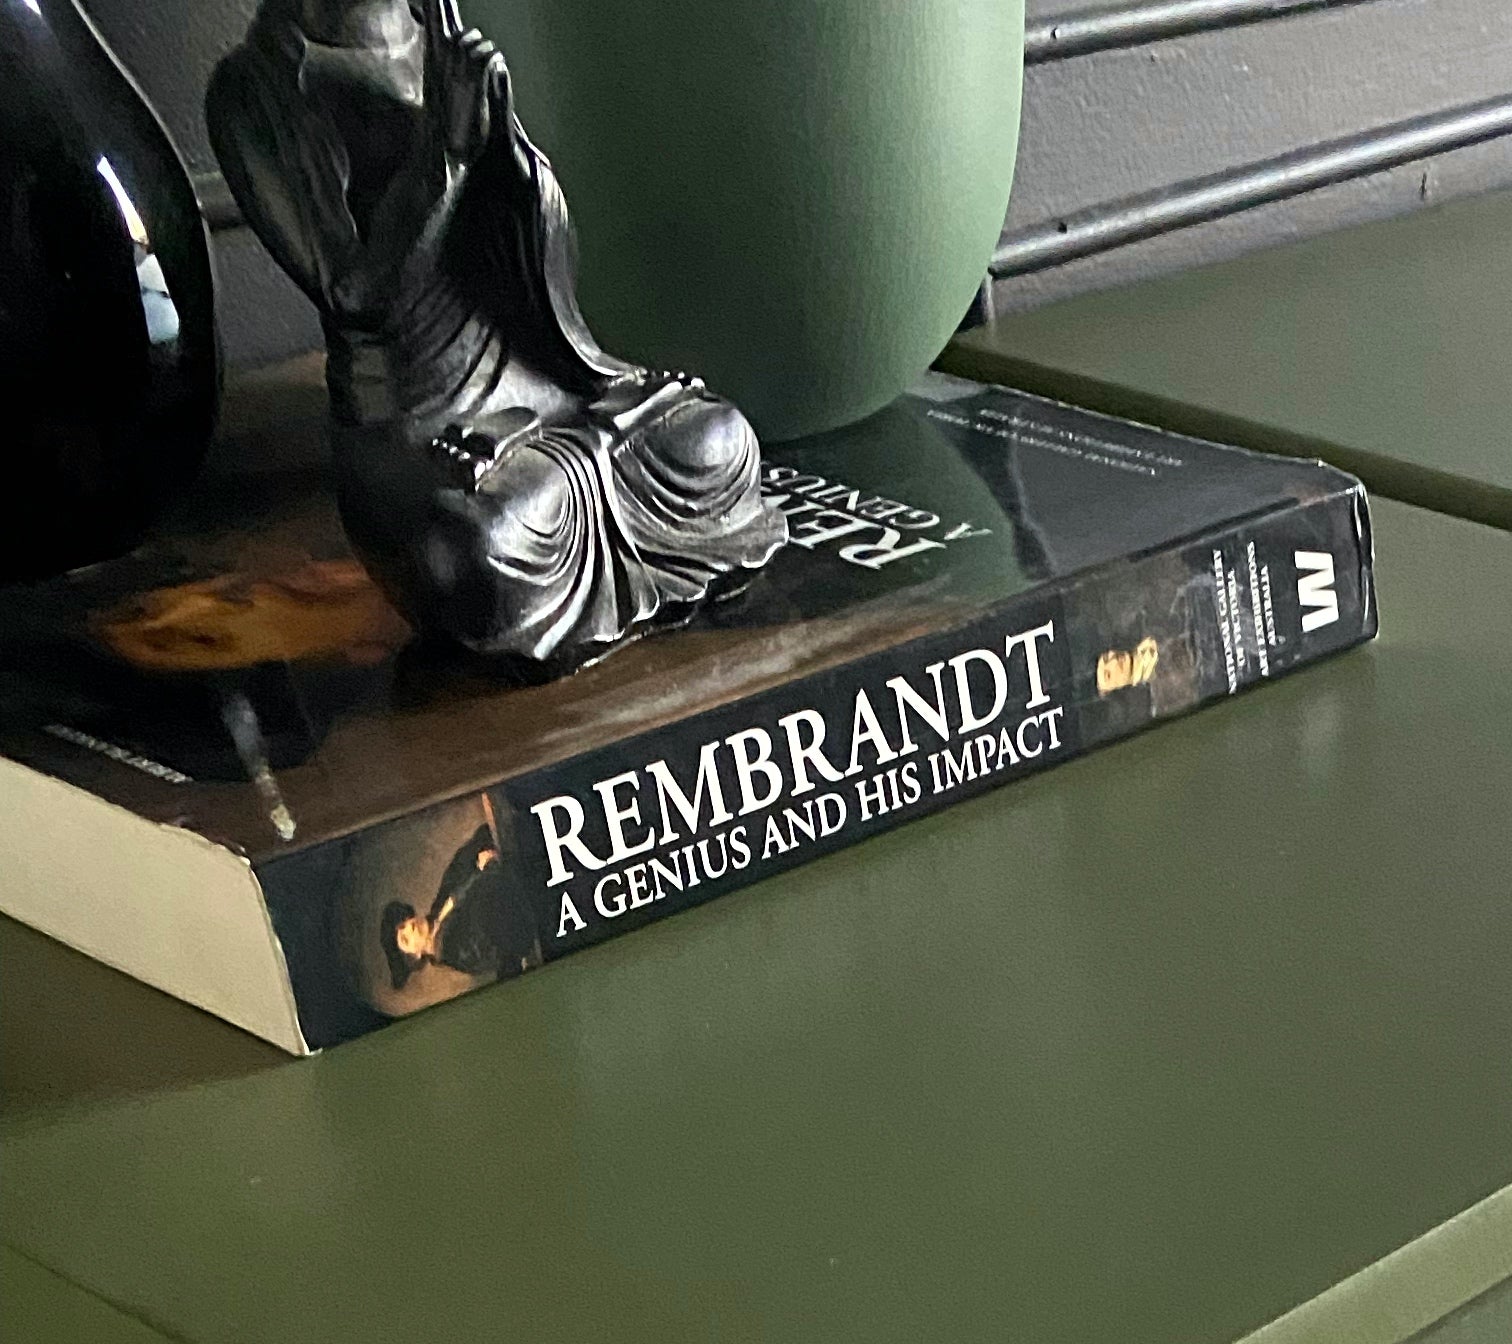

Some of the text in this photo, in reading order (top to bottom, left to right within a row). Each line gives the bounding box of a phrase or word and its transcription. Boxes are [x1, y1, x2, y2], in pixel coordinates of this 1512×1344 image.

[1261, 565, 1276, 646] AUSTRALIA
[1294, 551, 1339, 633] W
[530, 620, 1055, 888] REMBRANDT
[555, 706, 1064, 938] A GENIUS AND HIS IMPACT
